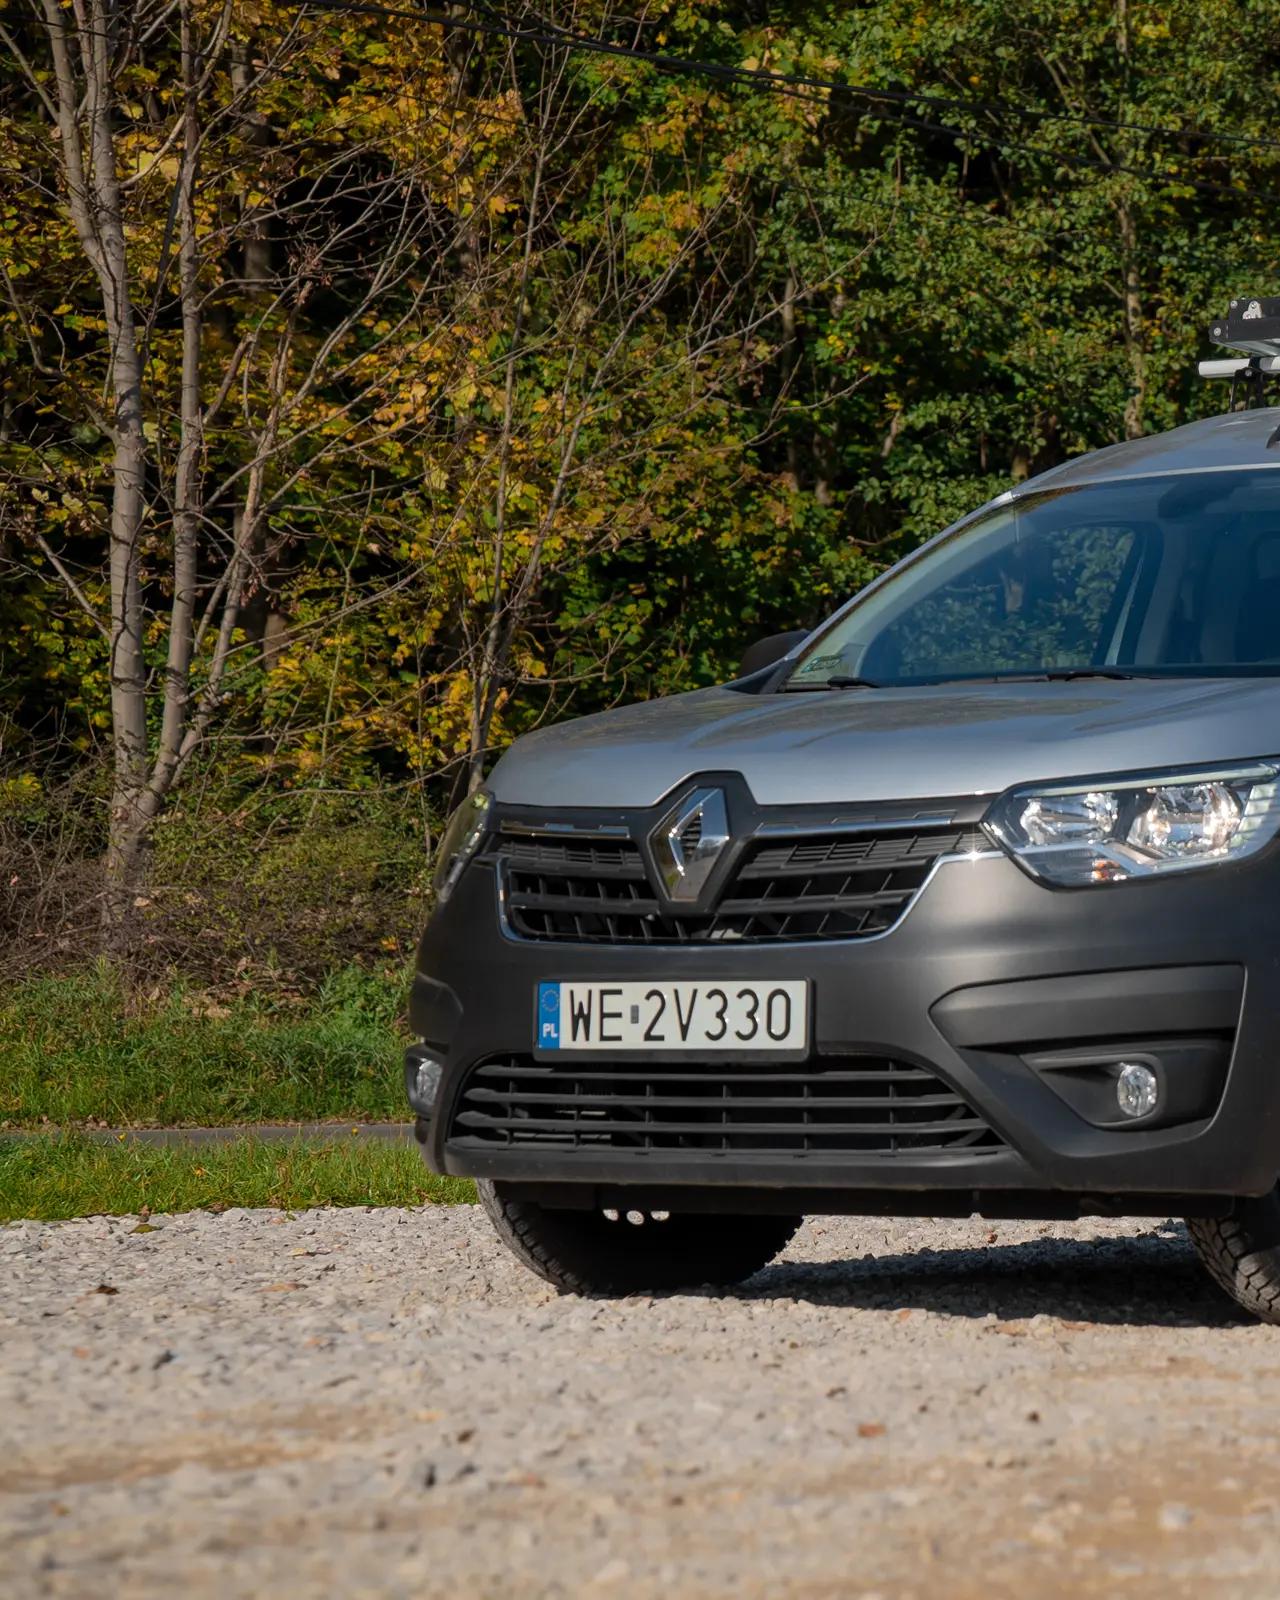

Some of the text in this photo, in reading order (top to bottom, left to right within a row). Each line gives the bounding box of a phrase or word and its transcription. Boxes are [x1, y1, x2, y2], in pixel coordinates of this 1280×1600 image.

[542, 1022, 558, 1038] PL
[569, 988, 792, 1042] WE 2V330
